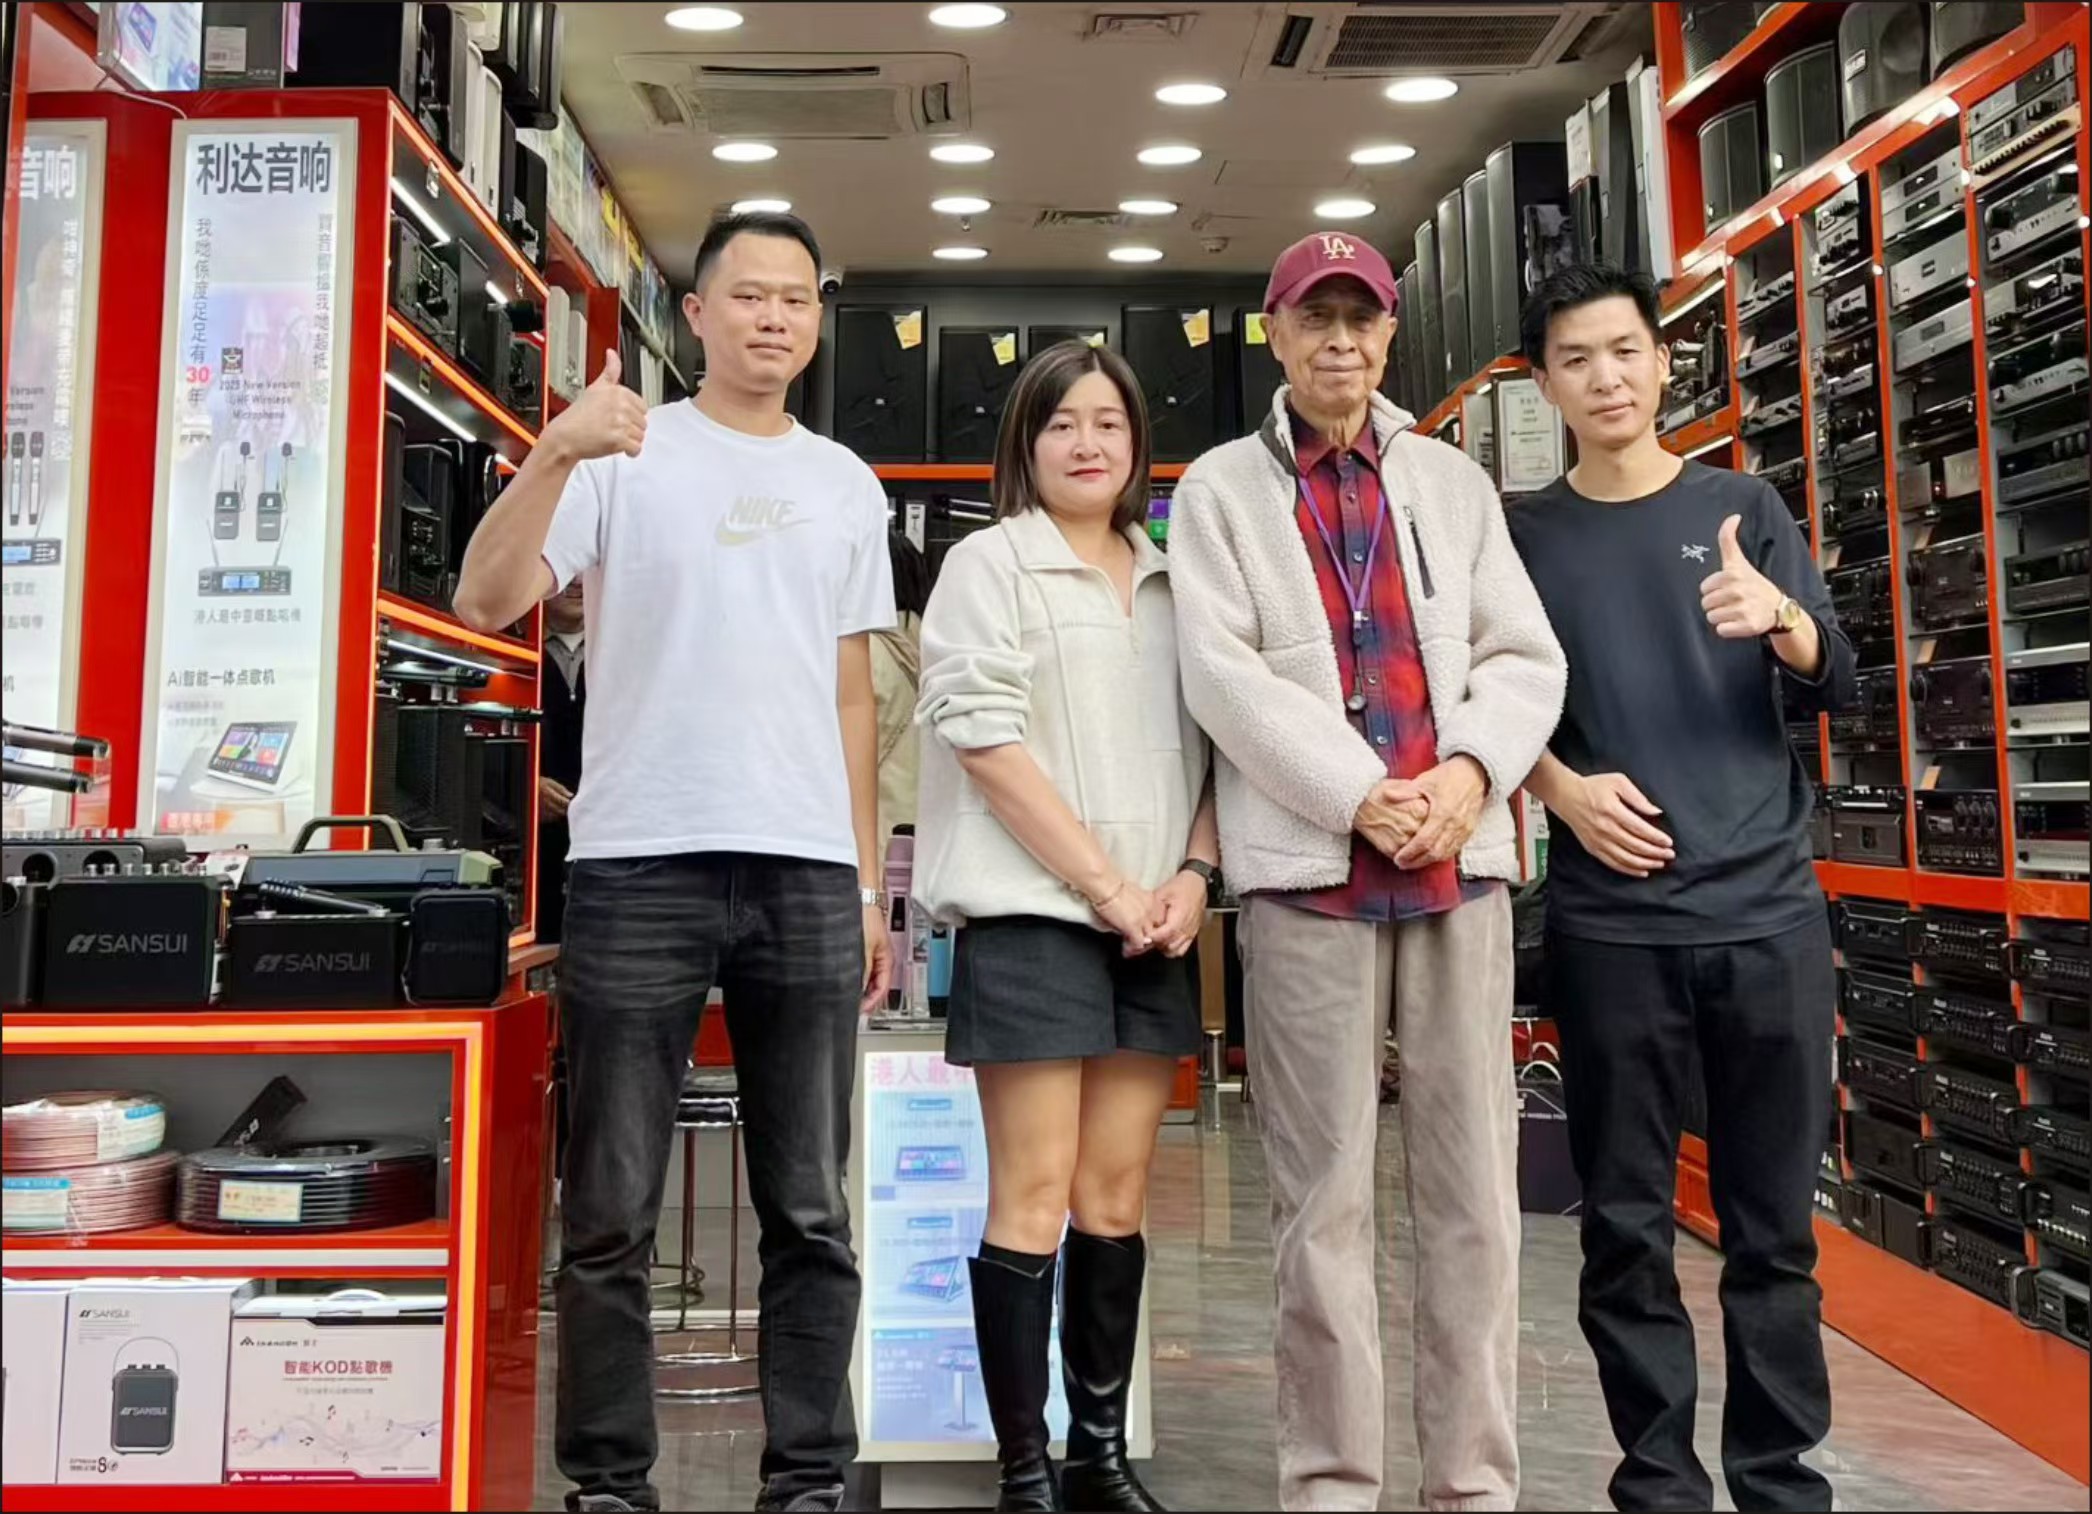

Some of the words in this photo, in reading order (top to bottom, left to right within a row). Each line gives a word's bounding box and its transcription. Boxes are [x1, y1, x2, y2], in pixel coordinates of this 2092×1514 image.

[196, 140, 332, 195] 利达音响
[1319, 235, 1356, 260] LA
[728, 495, 797, 525] NIKE
[98, 933, 188, 953] SANSUI
[284, 952, 370, 973] SANSUI
